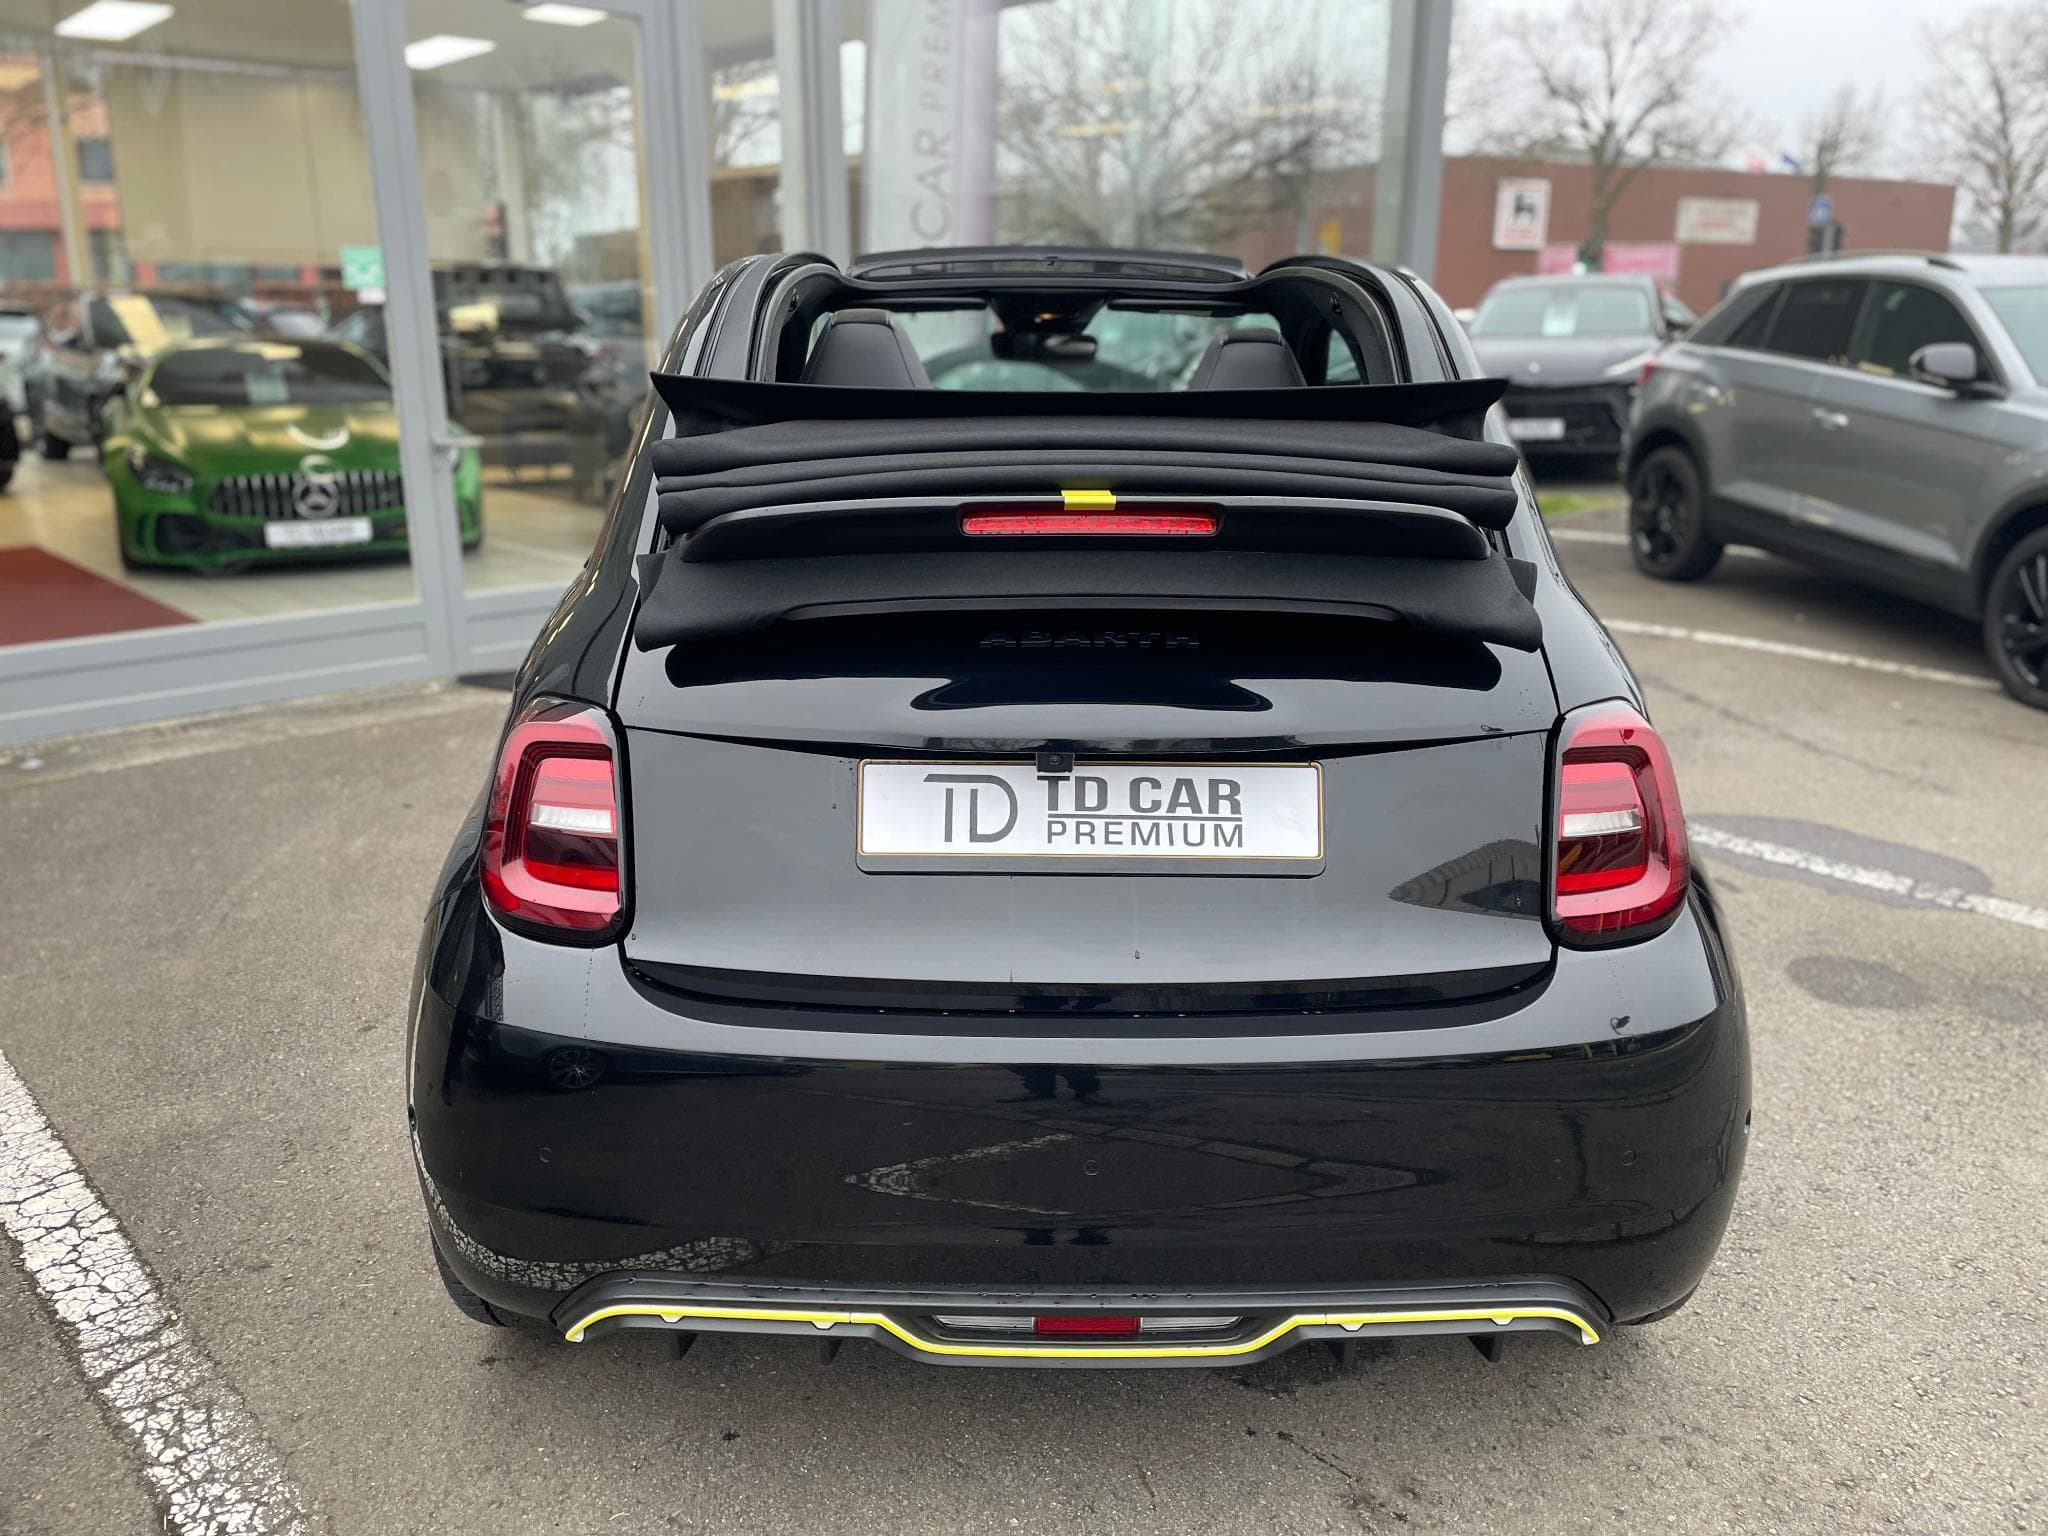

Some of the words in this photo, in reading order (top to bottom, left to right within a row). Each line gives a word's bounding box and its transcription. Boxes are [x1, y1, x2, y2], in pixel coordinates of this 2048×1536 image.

[909, 128, 953, 242] CAR
[979, 631, 1200, 649] ABARTH
[1036, 775, 1109, 812] TD
[1128, 776, 1243, 815] CAR
[1046, 820, 1244, 849] PREMIUM
